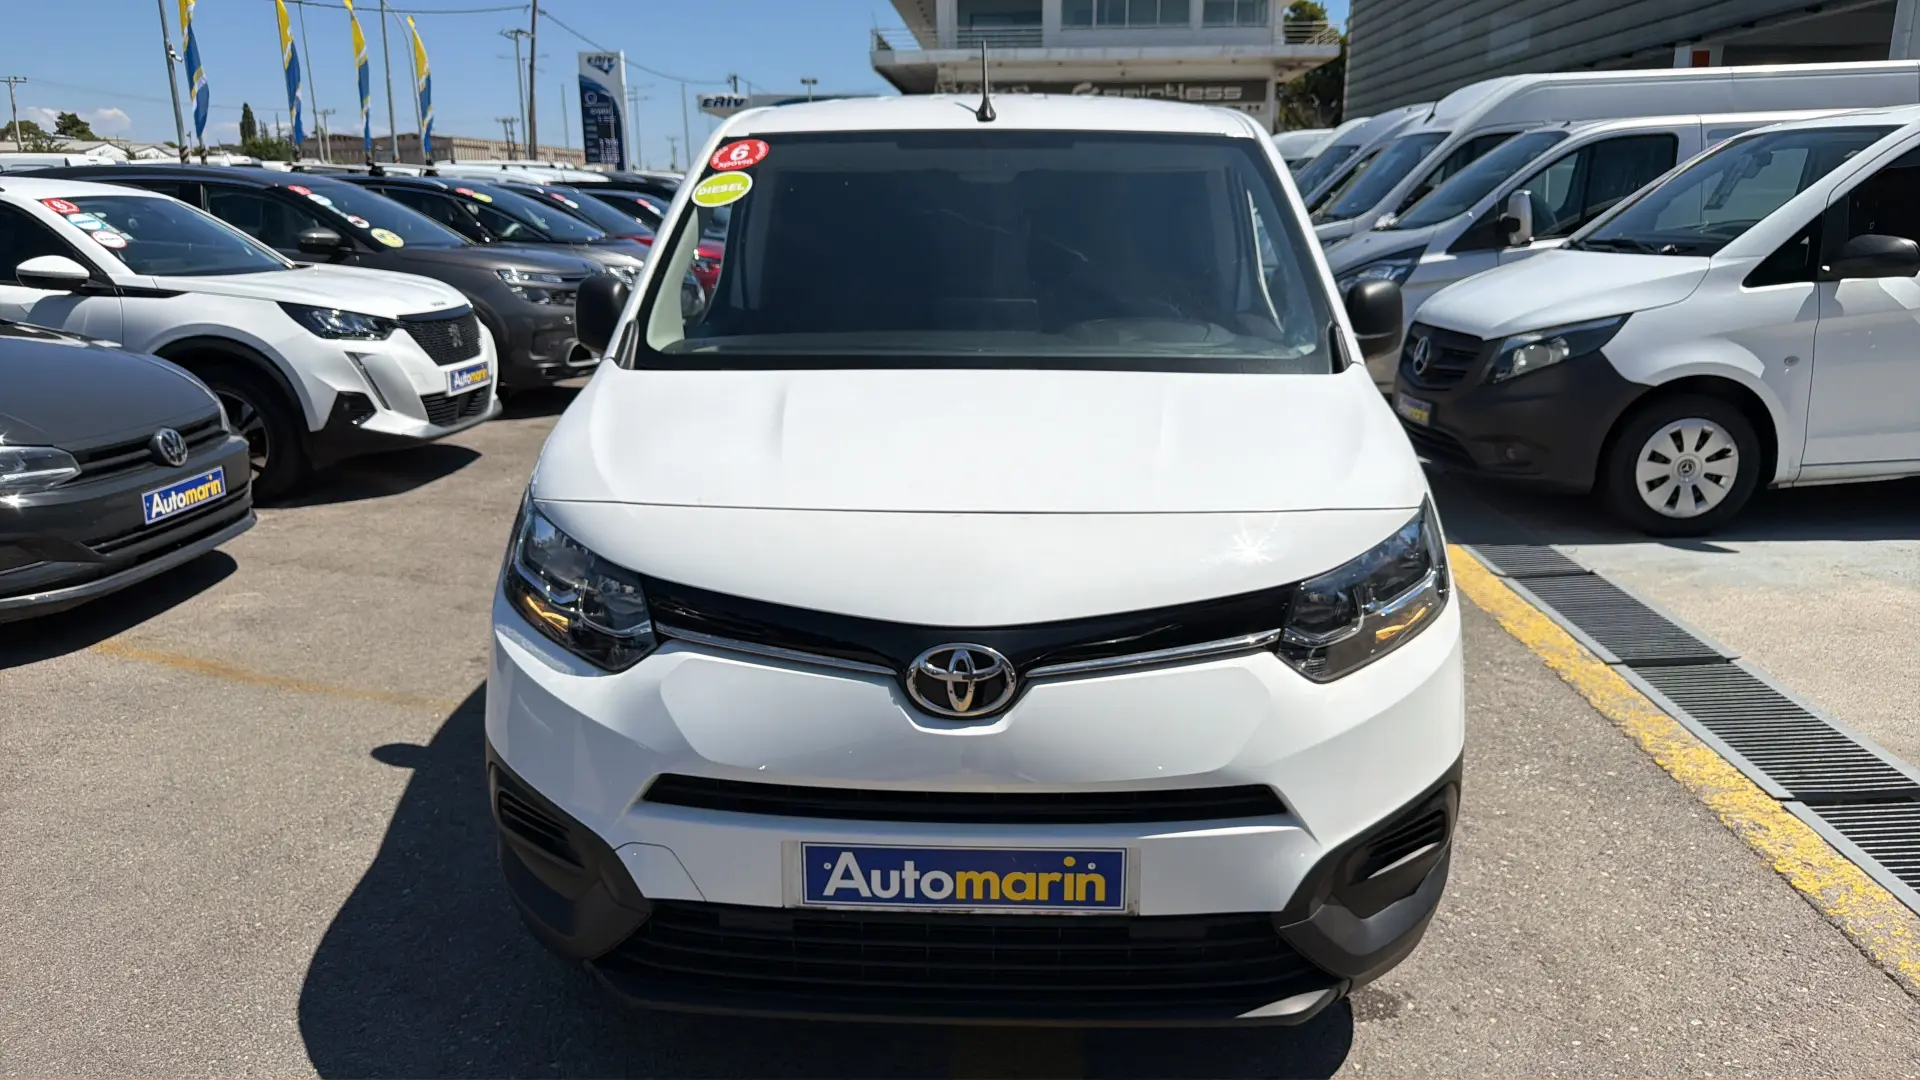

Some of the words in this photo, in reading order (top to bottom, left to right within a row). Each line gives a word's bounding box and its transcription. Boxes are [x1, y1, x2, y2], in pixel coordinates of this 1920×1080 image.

[730, 144, 750, 161] 6
[697, 183, 745, 196] DIESEL
[151, 474, 222, 518] Automarin
[822, 851, 1106, 902] Automarin
